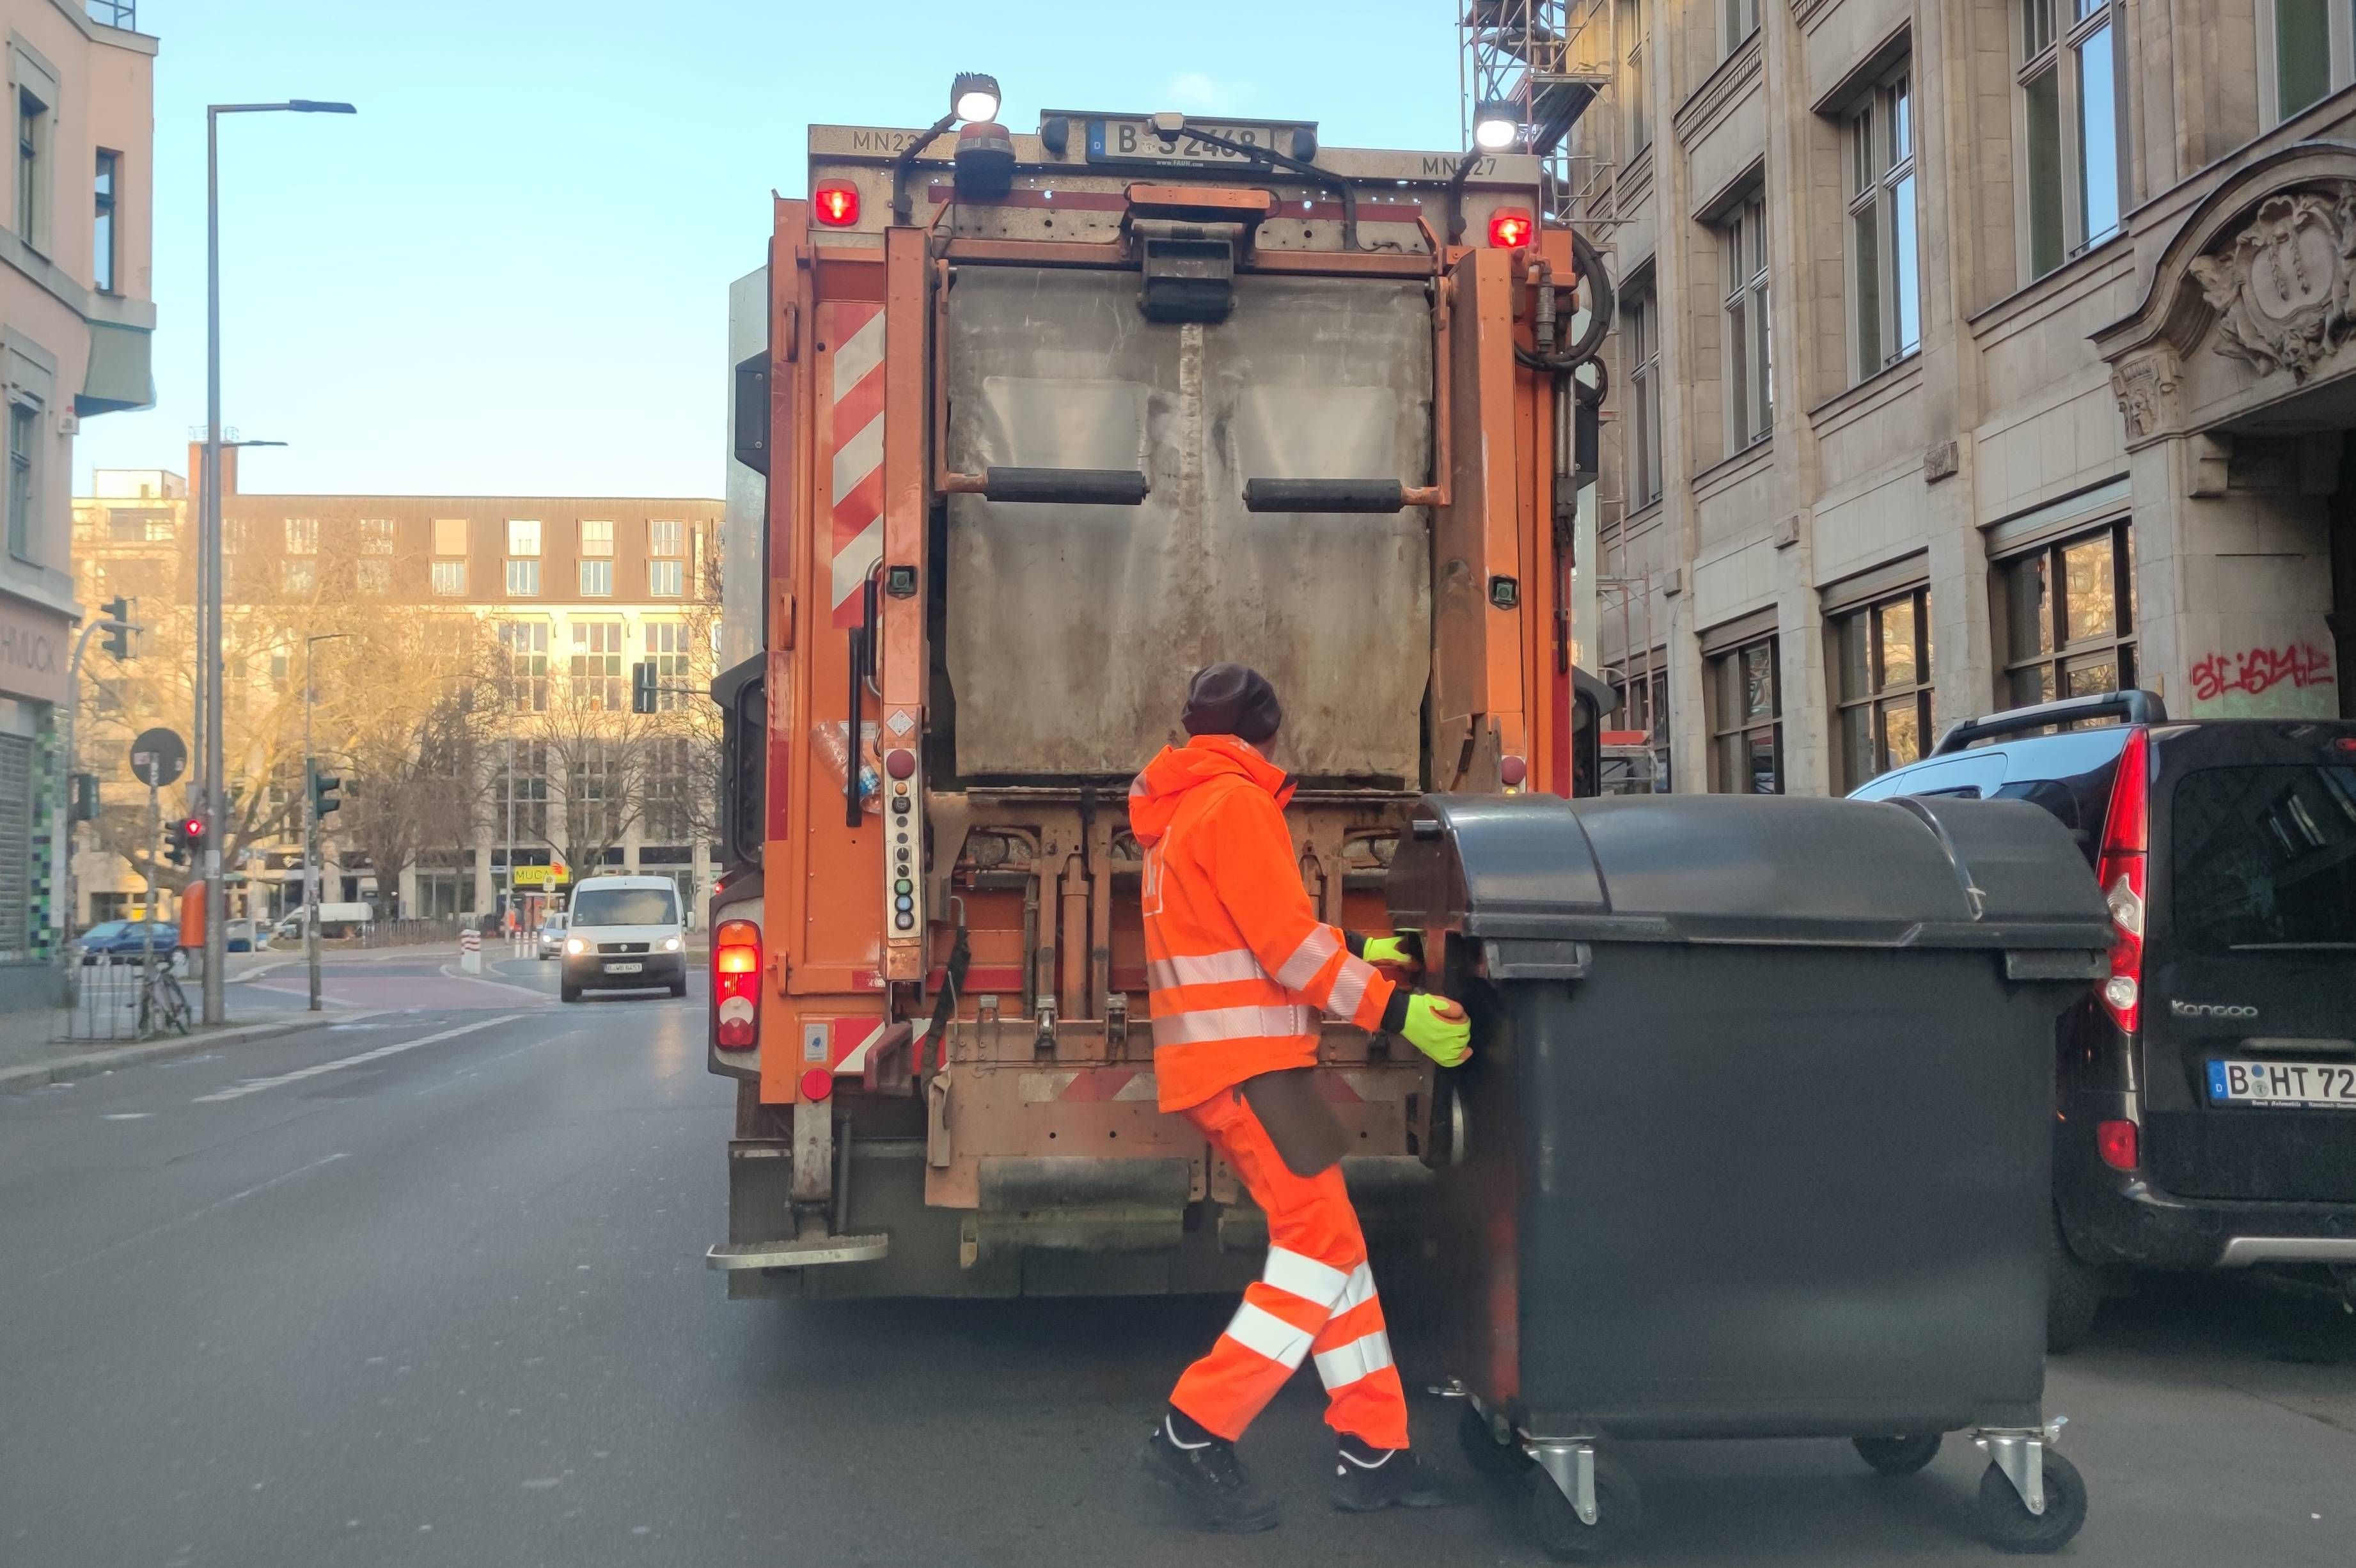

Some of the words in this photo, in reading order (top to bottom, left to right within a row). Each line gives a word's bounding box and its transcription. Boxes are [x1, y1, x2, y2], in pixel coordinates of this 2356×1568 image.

[854, 131, 929, 153] MN2
[1119, 125, 1137, 153] B
[1423, 157, 1496, 175] MN27
[2172, 1000, 2258, 1017] Kangoo
[2216, 1084, 2223, 1092] D
[2229, 1065, 2249, 1095] B
[2270, 1067, 2309, 1096] HT
[2318, 1068, 2356, 1098] 72
